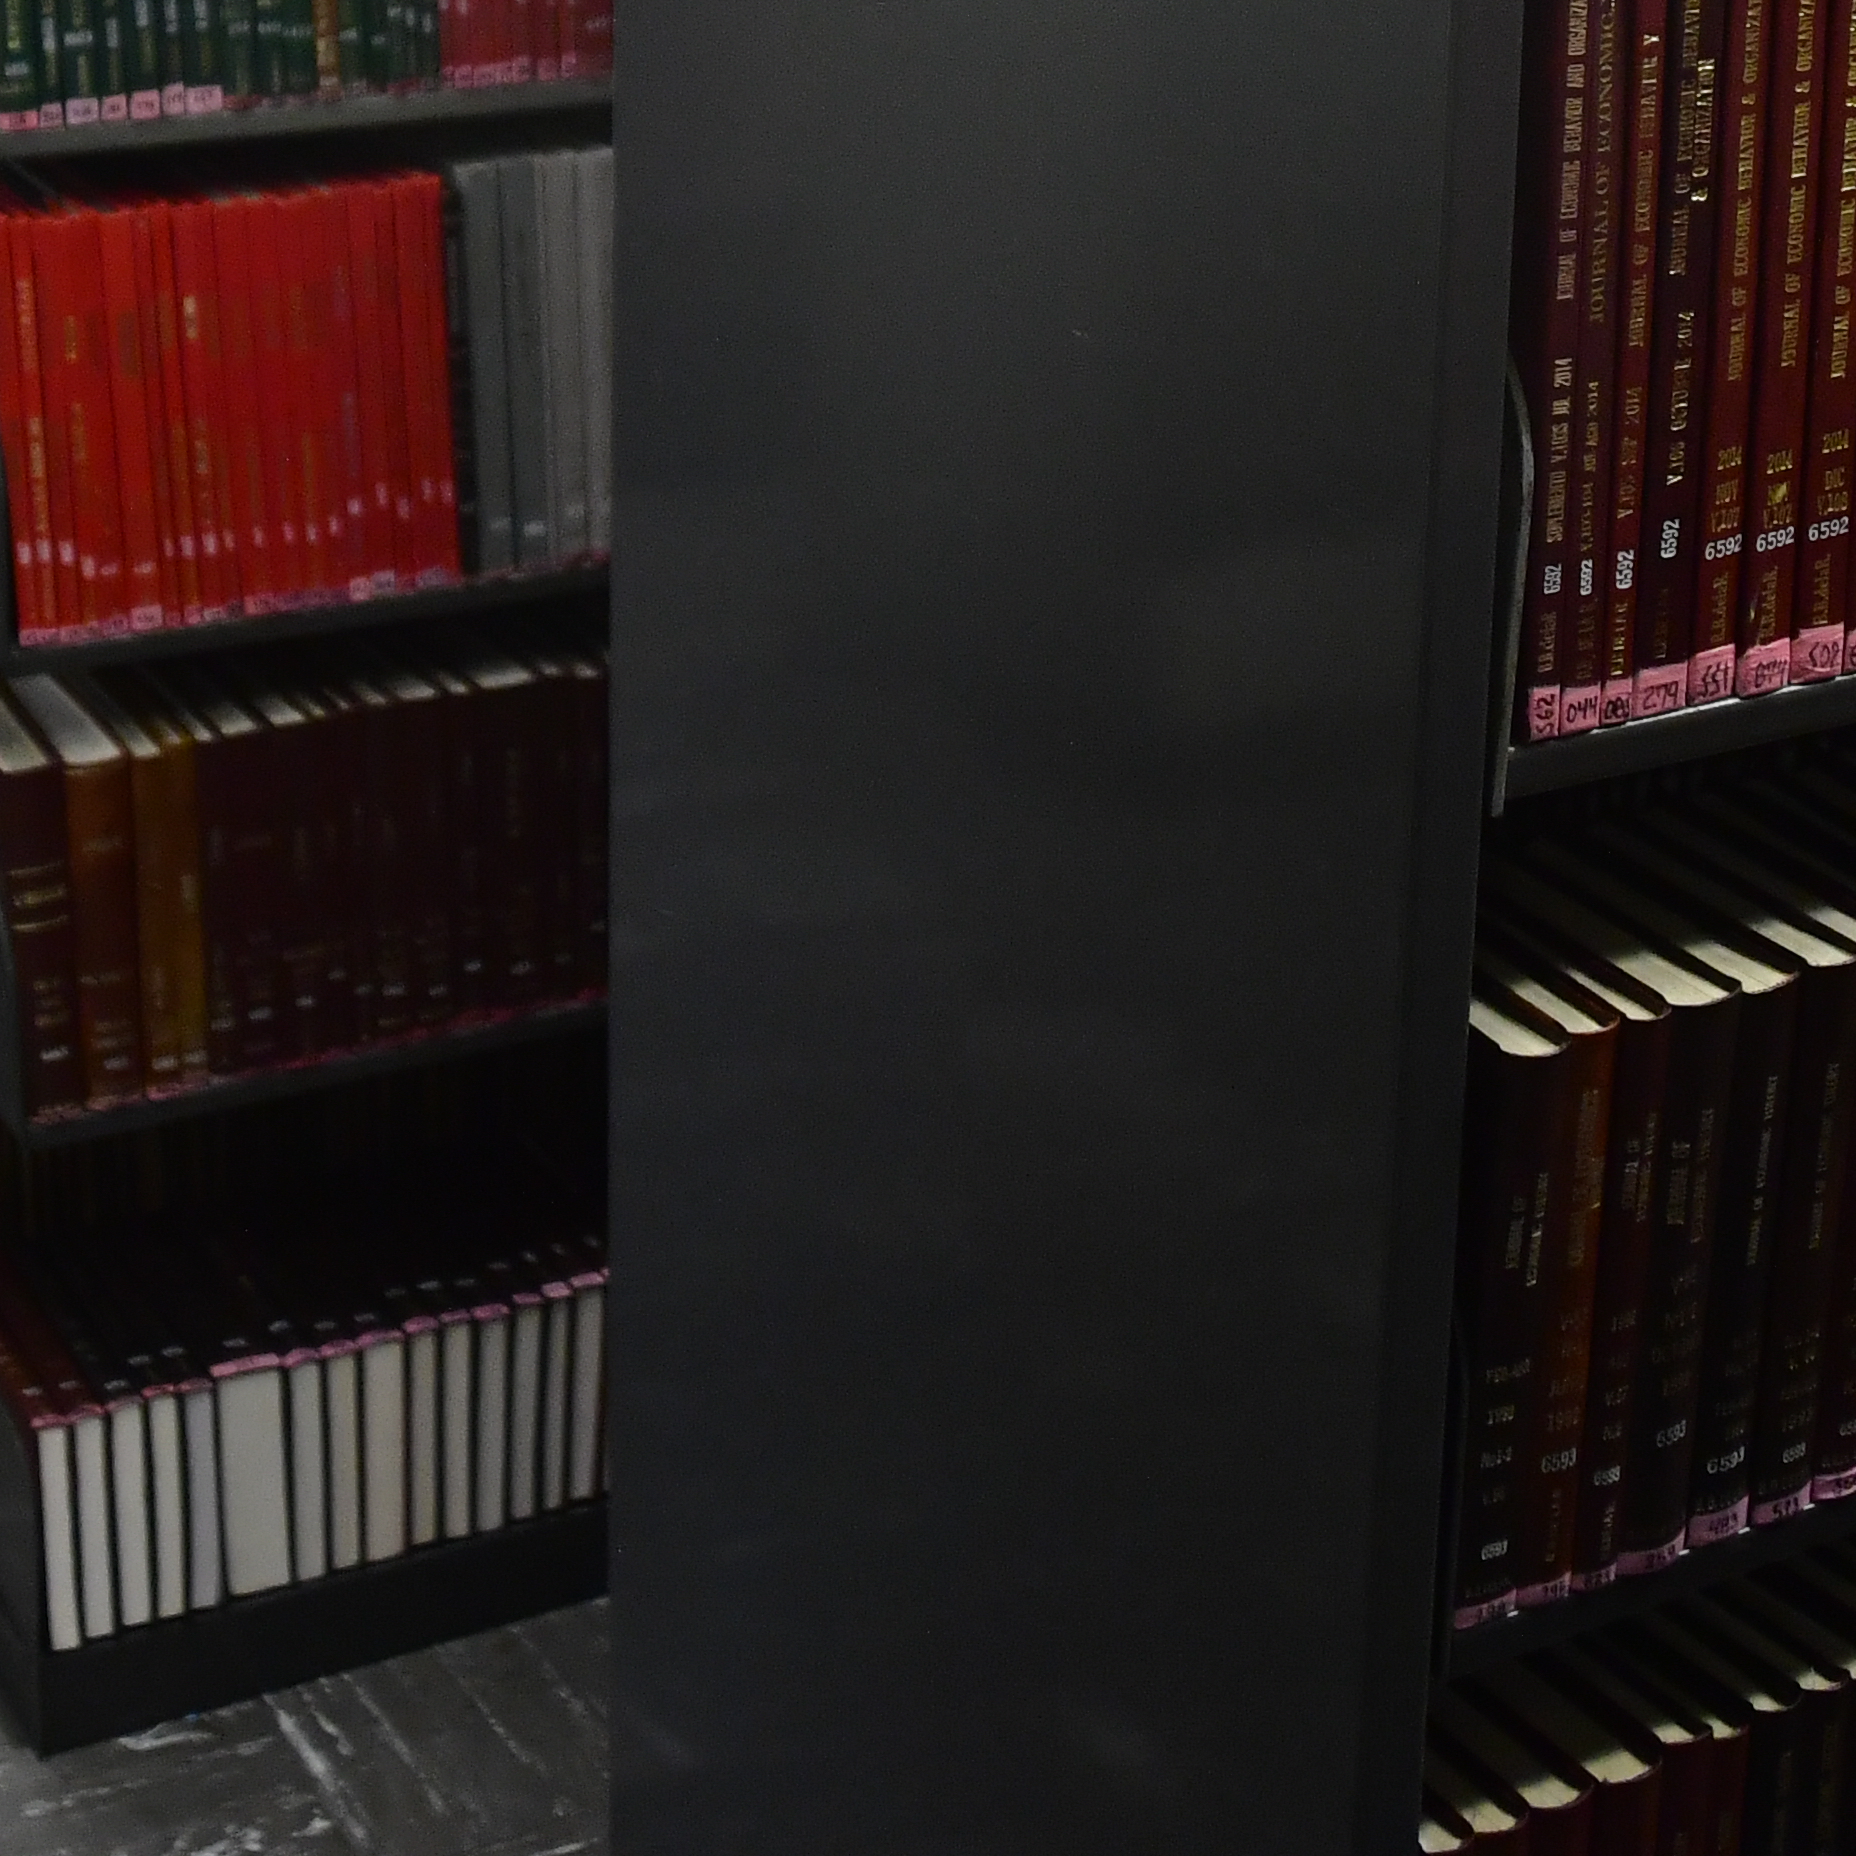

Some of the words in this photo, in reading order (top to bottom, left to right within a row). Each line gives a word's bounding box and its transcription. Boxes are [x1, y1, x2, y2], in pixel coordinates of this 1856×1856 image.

[1566, 63, 1586, 88] AND
[1564, 98, 1583, 152] BEHAVIOR
[1561, 161, 1581, 219] ECONOMIC
[1561, 228, 1578, 242] OF
[1556, 254, 1577, 300] JOURNAL
[1554, 358, 1572, 387] 2014
[1704, 534, 1743, 560] 6592
[1543, 564, 1562, 594] 6592
[1542, 1447, 1577, 1473] 6593
[1707, 1445, 1746, 1474] 6593
